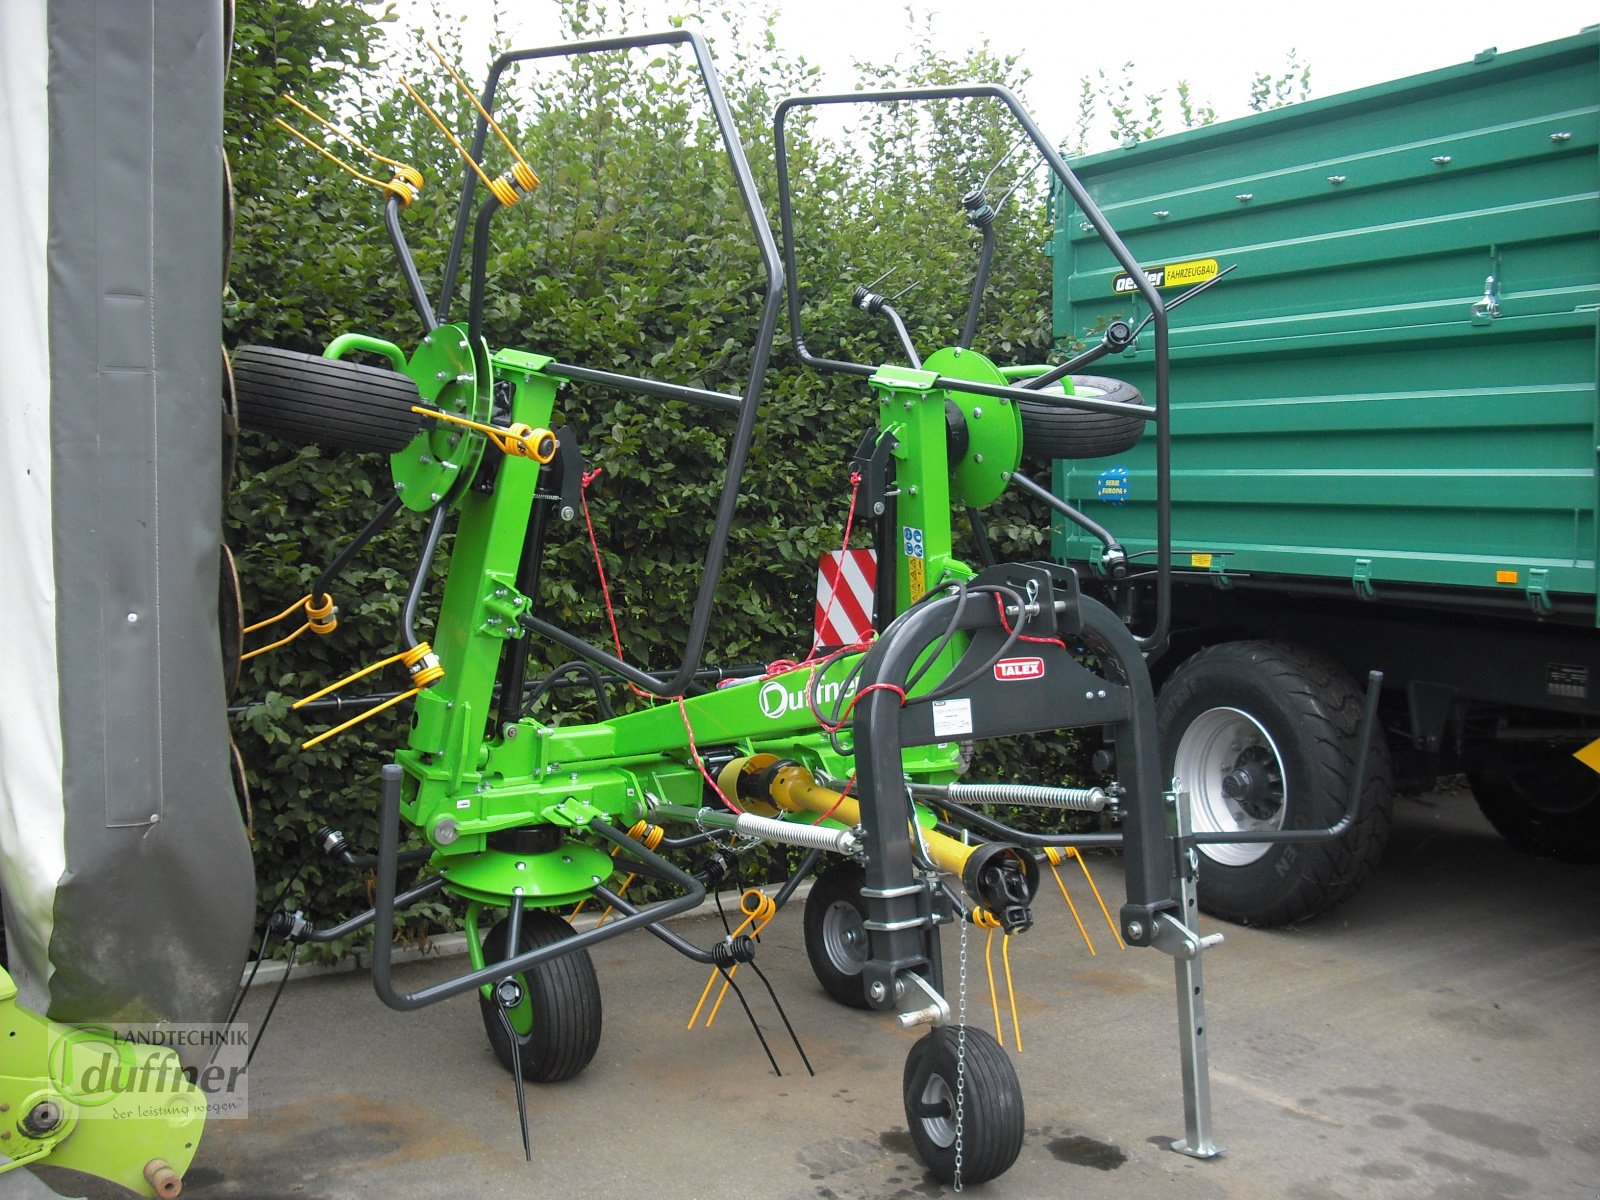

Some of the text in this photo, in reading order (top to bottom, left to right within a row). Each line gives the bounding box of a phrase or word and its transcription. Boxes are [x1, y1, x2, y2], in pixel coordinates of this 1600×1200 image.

[1116, 264, 1216, 291] oeer FAHRZEUGBAU
[996, 660, 1041, 677] TALEX
